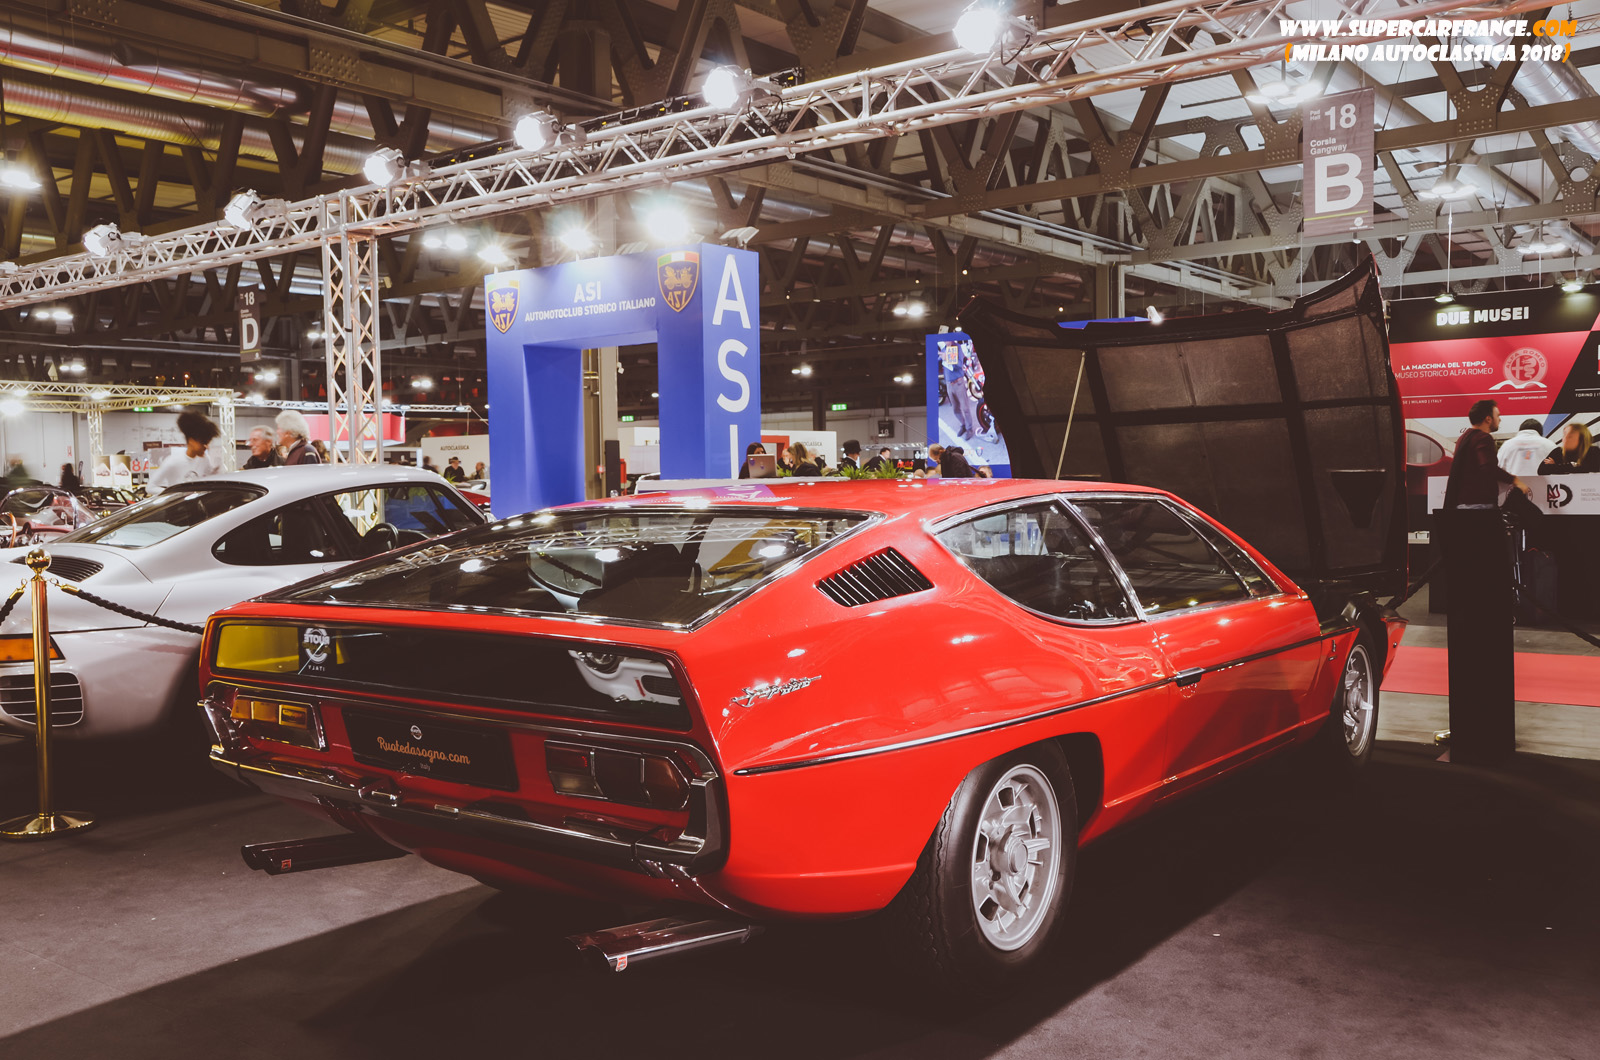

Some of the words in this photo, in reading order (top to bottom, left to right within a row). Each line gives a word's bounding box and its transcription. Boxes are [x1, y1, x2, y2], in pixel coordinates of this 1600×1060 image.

[1324, 103, 1357, 131] 18
[1309, 136, 1337, 148] Corsia
[1309, 143, 1348, 155] Gangway
[1314, 152, 1364, 214] B
[244, 291, 255, 306] 18
[573, 281, 602, 303] ASI
[524, 304, 584, 323] AUTOMOTOCLUB
[584, 302, 618, 317] STORICO
[618, 297, 656, 312] ITALIANO
[1436, 310, 1470, 327] DUE
[1473, 306, 1529, 323] MUSEI
[241, 317, 259, 351] D
[1394, 371, 1419, 379] MUSEO
[1419, 369, 1449, 378] STORICO
[1449, 368, 1467, 377] ALFA
[1467, 366, 1494, 376] ROMEO
[1462, 360, 1487, 368] TEMPO
[376, 736, 471, 765] Ruotedasogno.com
